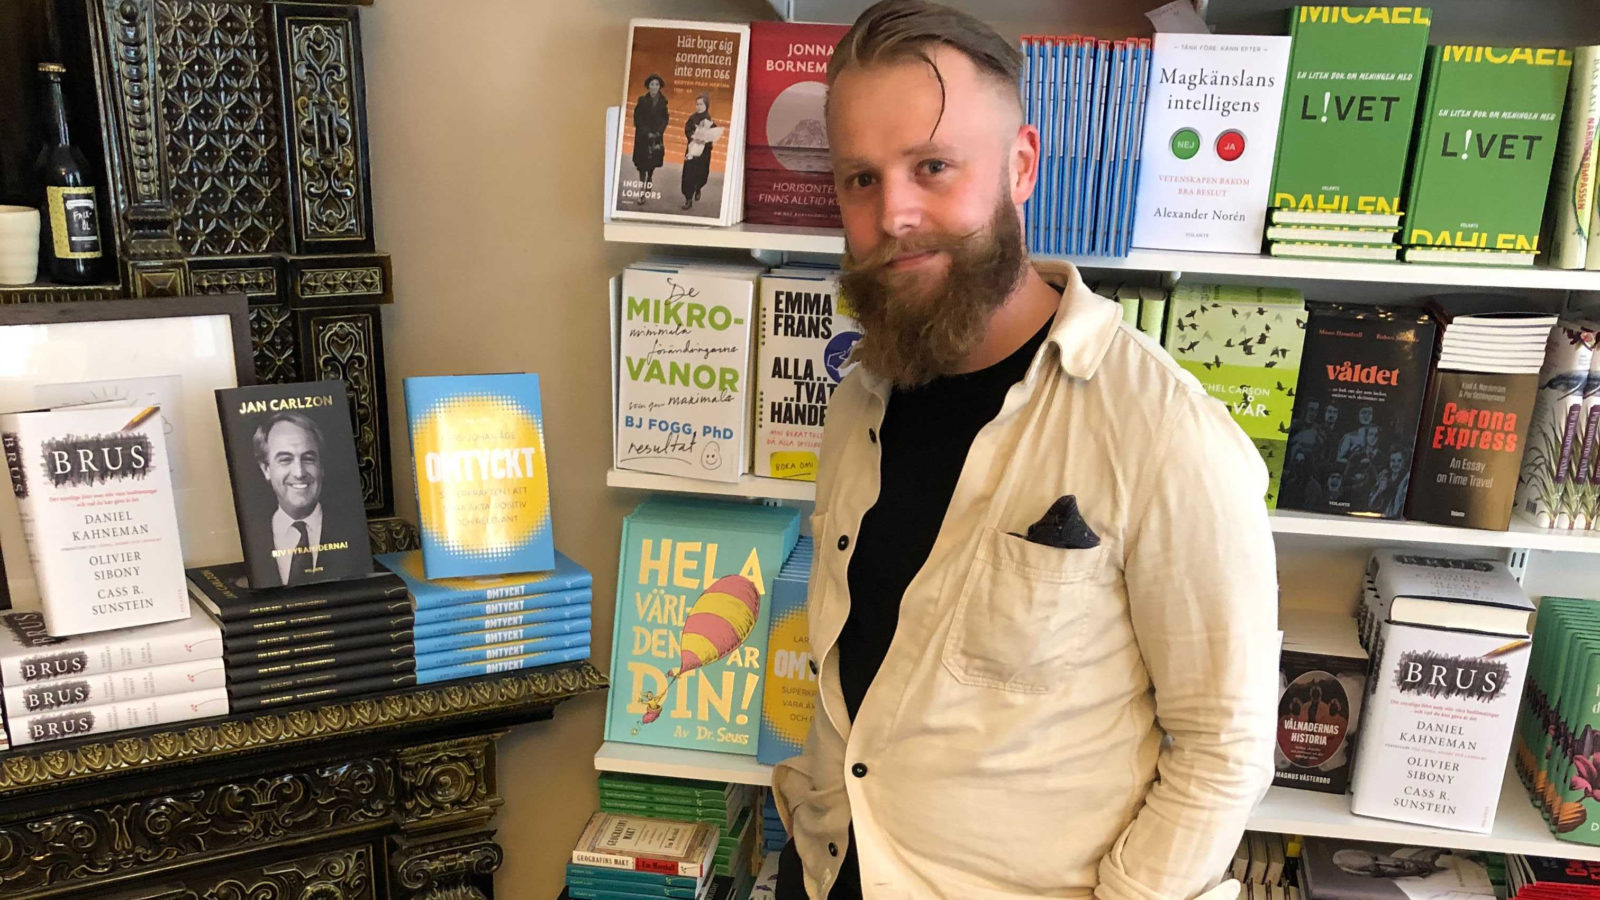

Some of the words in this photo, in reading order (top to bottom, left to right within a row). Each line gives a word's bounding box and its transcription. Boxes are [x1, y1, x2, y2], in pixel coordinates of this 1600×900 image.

[1300, 6, 1430, 26] MICAEL
[677, 35, 696, 48] Här
[697, 35, 718, 53] bryr
[719, 37, 733, 54] sig
[787, 43, 834, 57] JONNA
[676, 52, 732, 66] sommaren
[1443, 45, 1572, 66] MICAEL
[674, 65, 693, 77] inte
[695, 67, 712, 78] om
[713, 69, 730, 80] oss
[766, 60, 828, 73] BORNEM
[1160, 67, 1275, 91] Magkänslans
[1167, 94, 1260, 117] intelligens
[1301, 91, 1400, 123] L!VET
[1177, 140, 1195, 149] NEJ
[1224, 142, 1236, 151] JA
[1441, 129, 1543, 160] L!VET
[623, 180, 653, 190] INGRID
[773, 182, 835, 193] HORISONTE
[1159, 175, 1217, 185] VETENSKAPEN
[622, 189, 662, 200] LOMFORS
[759, 193, 789, 204] FINNS
[791, 195, 827, 206] ALLTID
[1178, 188, 1194, 196] BRA
[1196, 188, 1227, 197] BESLUT
[1153, 207, 1208, 220] Alexander
[1212, 209, 1246, 222] Norén
[664, 277, 700, 306] De
[774, 290, 832, 316] EMMA
[627, 296, 744, 331] MIKRO-
[773, 314, 832, 339] FRANS
[625, 356, 740, 392] VANOR
[771, 356, 814, 381] ALLA
[1326, 361, 1400, 386] våldet
[794, 376, 838, 405] TVÄT
[1201, 383, 1226, 393] CHEL
[1228, 385, 1270, 397] CARSON
[239, 399, 267, 415] JAN
[270, 395, 333, 411] CARLZON
[770, 396, 826, 426] HÄNDE
[1233, 395, 1267, 417] VÅR
[1443, 402, 1517, 432] Corona
[625, 416, 643, 429] BJ
[702, 425, 734, 440] PhD
[628, 430, 698, 454] resultat
[1432, 426, 1518, 452] Express
[4, 436, 23, 494] BRUS
[52, 444, 145, 475] BRUS
[1450, 457, 1461, 468] An
[1462, 458, 1486, 473] Essay
[1437, 474, 1447, 483] on
[1448, 473, 1468, 486] Time
[1469, 475, 1494, 489] Travel
[84, 511, 133, 525] DANIEL
[72, 524, 149, 542] KAHNEMAN
[89, 551, 142, 566] OLIVIER
[638, 538, 765, 595] HELA
[94, 566, 141, 581] SIBONY
[97, 585, 128, 600] CASS
[133, 585, 144, 595] R.
[91, 598, 154, 615] SUNSTEIN
[25, 657, 82, 679] BRUS
[1405, 661, 1498, 693] BRUS
[28, 687, 85, 708] BRUS
[626, 662, 759, 725] DIN!
[33, 717, 90, 738] BRUS
[673, 725, 690, 739] Av
[696, 727, 714, 741] Dr.
[717, 727, 749, 745] Seuss
[1284, 718, 1339, 735] VÅLNADERNAS
[1417, 720, 1465, 735] DANIEL
[1291, 732, 1327, 746] HISTORIA
[1399, 732, 1477, 751] KAHNEMAN
[1407, 756, 1460, 772] OLIVIER
[1276, 771, 1299, 780] MAGNUS
[1407, 770, 1455, 785] SIBONY
[1404, 785, 1435, 799] CASS
[1440, 791, 1451, 801] R.
[1393, 797, 1457, 815] SUNSTEIN
[577, 855, 612, 865] GEOGRAFINS
[613, 858, 629, 867] MAKT
